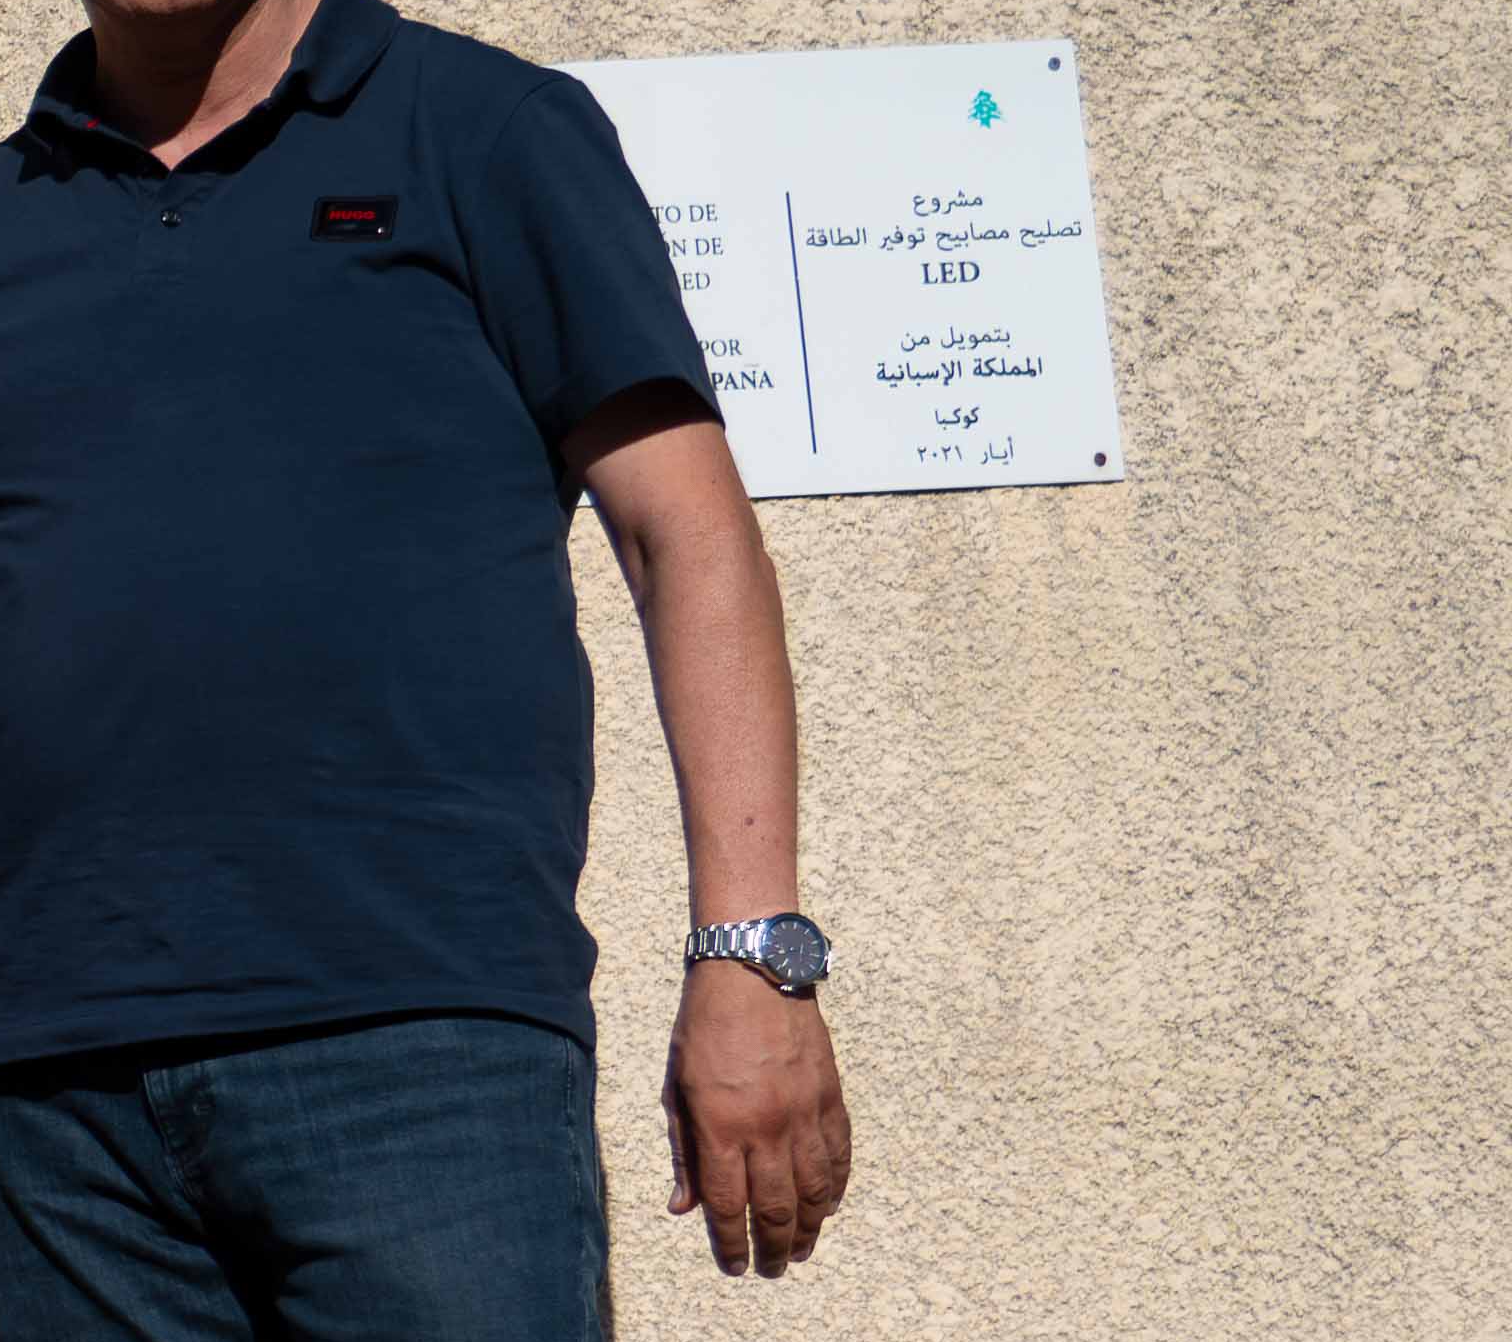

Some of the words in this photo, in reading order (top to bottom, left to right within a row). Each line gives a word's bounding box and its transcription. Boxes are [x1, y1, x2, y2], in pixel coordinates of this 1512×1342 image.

[328, 210, 376, 220] HUGO
[689, 203, 718, 223] DE
[913, 190, 984, 217] مشروع
[806, 227, 867, 247] الطاقة
[880, 225, 926, 251] توفير
[935, 222, 1010, 251] مصابيح
[1019, 219, 1083, 248] تصليح
[695, 237, 724, 256] DE
[682, 272, 711, 291] ED
[922, 261, 980, 285] LED
[901, 332, 931, 352] من
[940, 326, 1011, 350] بتمويل
[711, 362, 774, 391] PAÑA
[876, 360, 963, 388] الإسبانية
[972, 356, 1043, 378] المملكة
[934, 407, 980, 430] كوكبا
